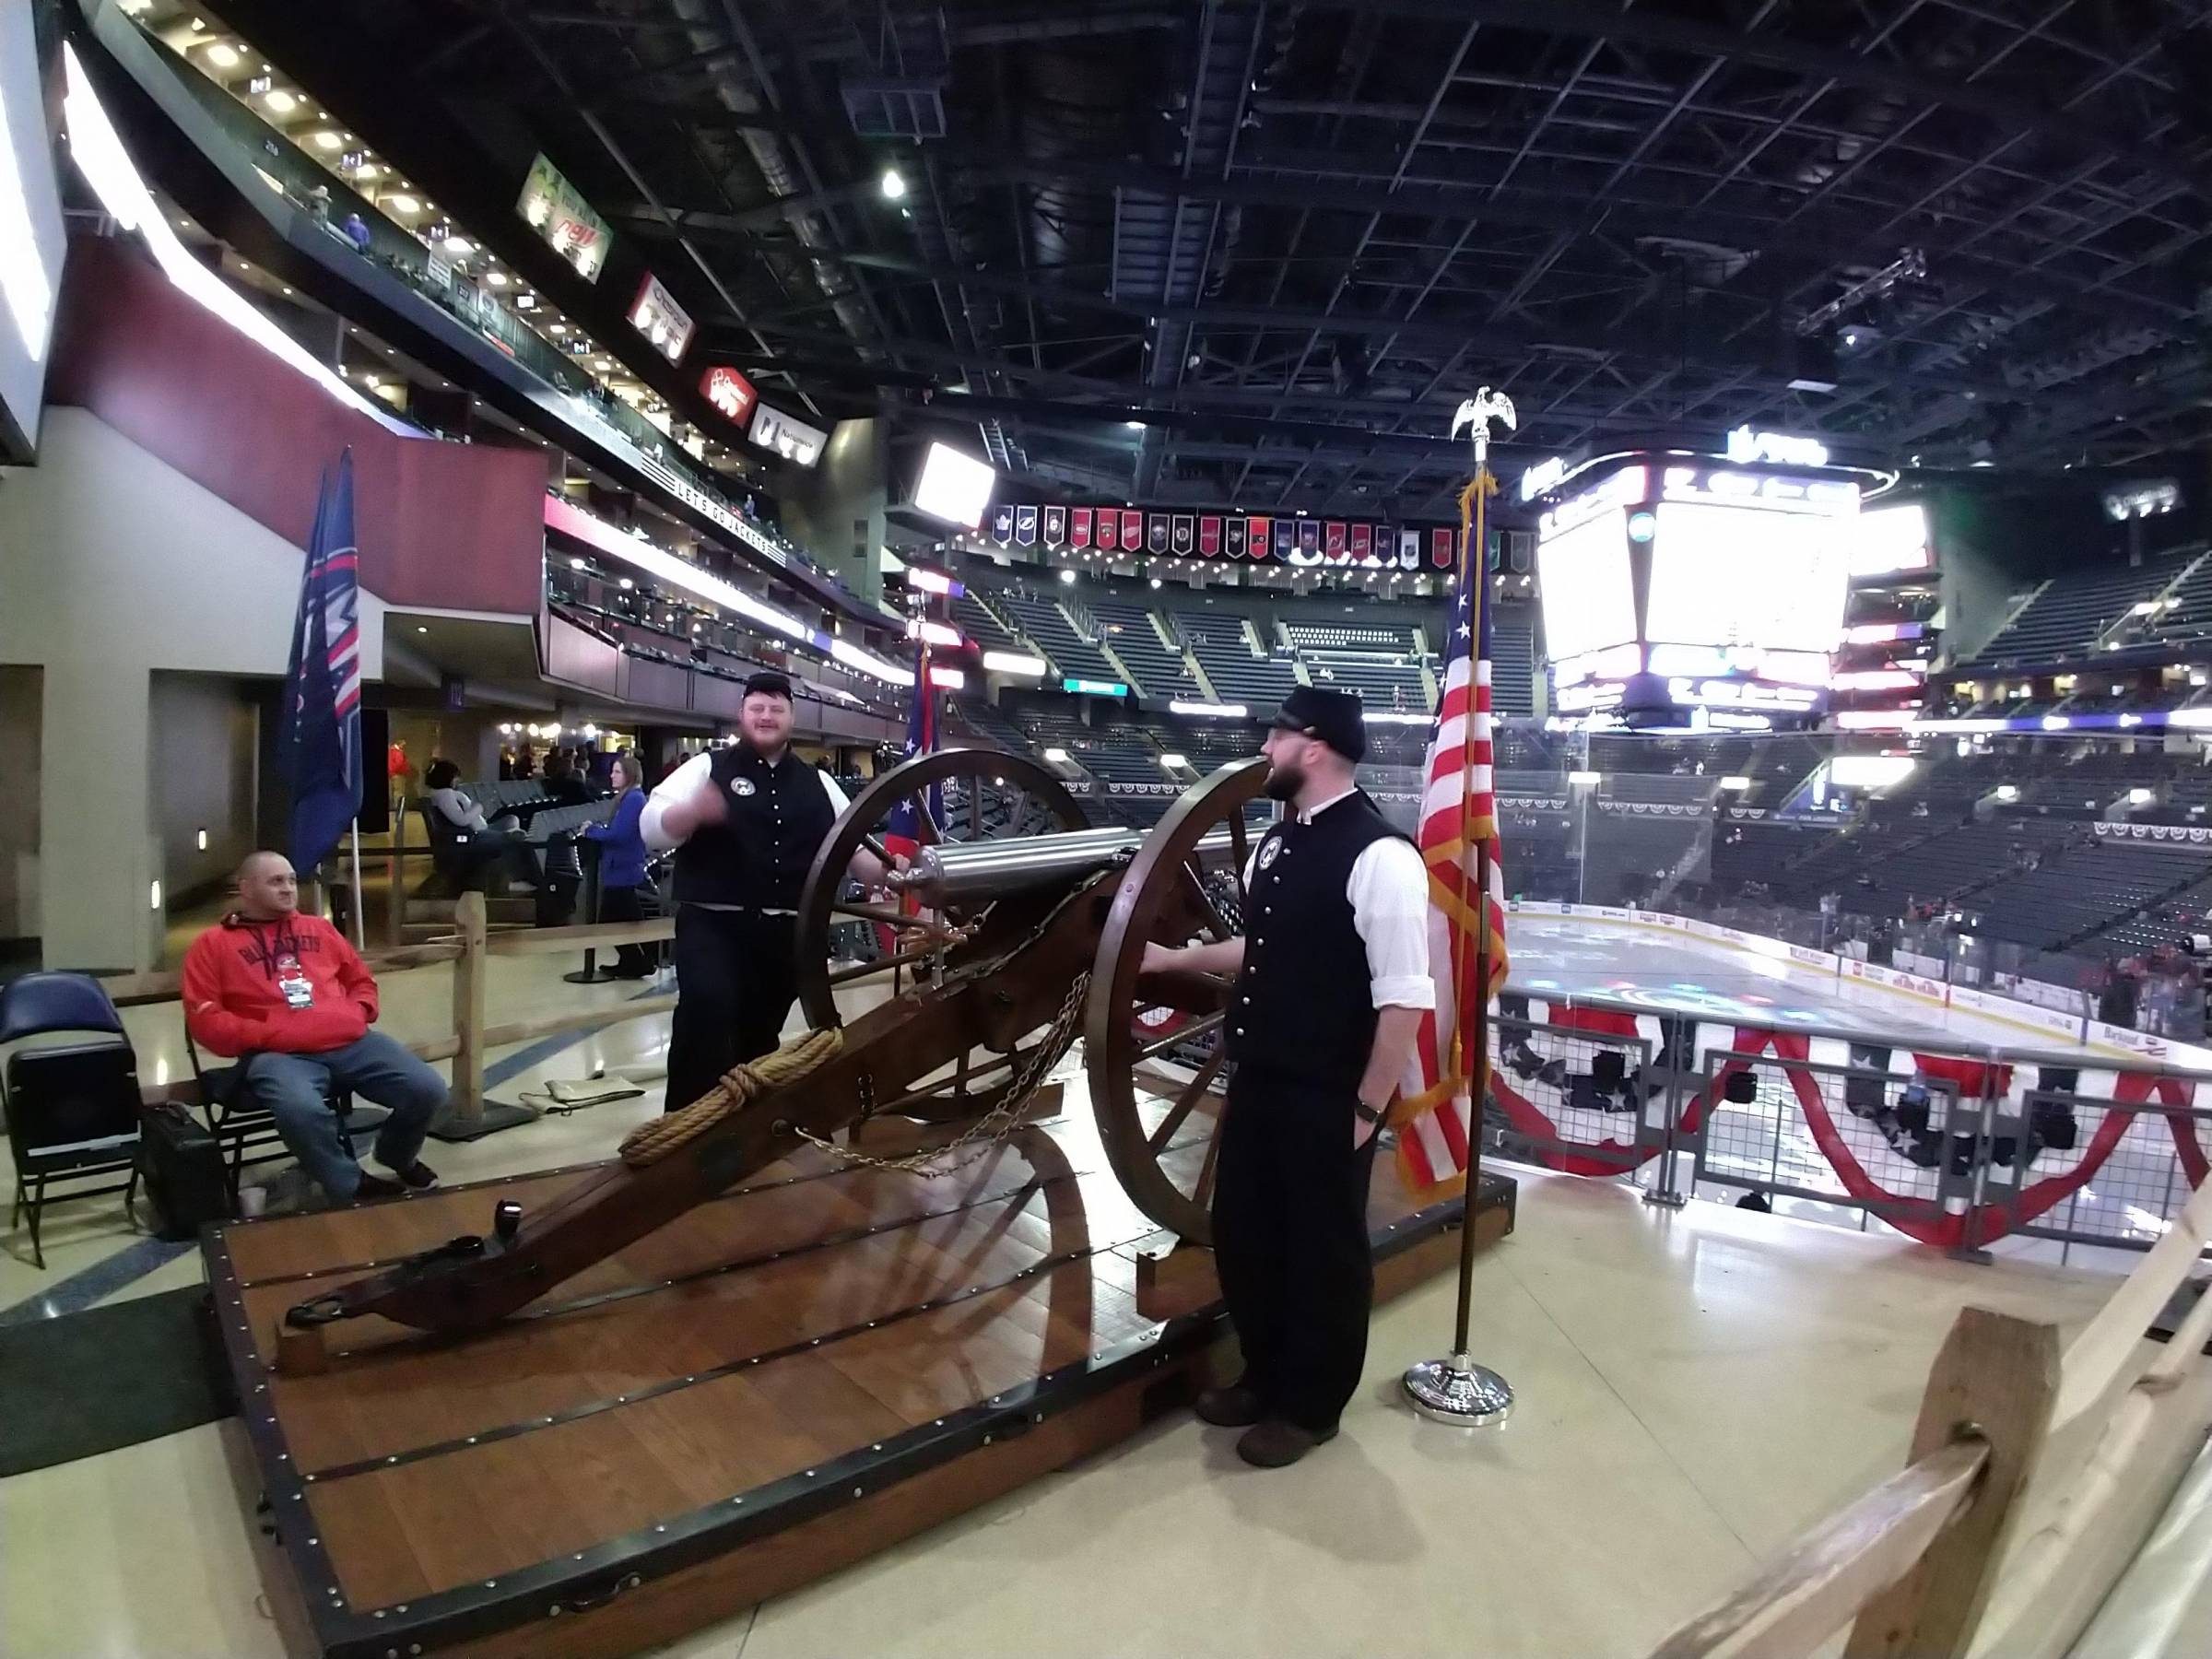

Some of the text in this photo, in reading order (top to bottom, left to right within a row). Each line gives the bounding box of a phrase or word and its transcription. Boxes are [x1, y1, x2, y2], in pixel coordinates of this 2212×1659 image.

[677, 483, 766, 551] LETS GO JACKETS
[238, 935, 321, 966] BLU ACETS
